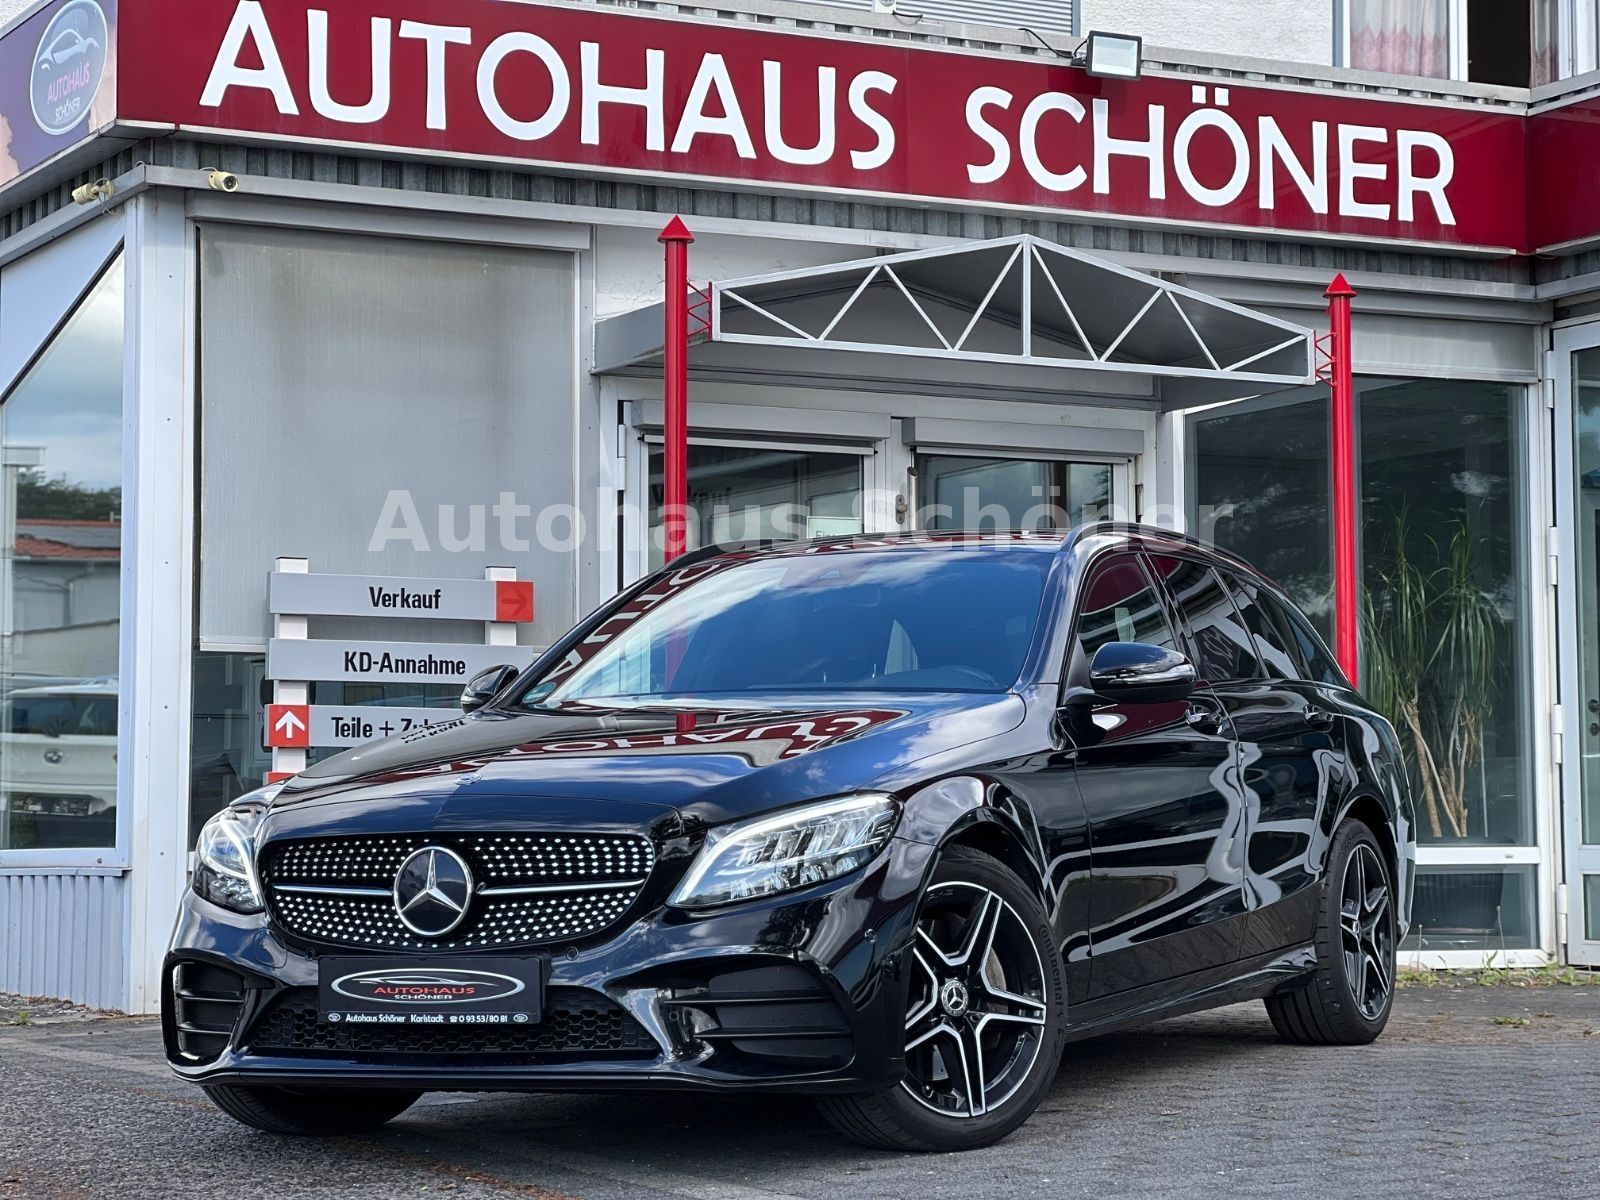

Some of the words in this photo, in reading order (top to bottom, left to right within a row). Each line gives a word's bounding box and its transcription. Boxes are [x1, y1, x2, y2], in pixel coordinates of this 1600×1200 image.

[47, 62, 90, 104] AUTOHAUS
[55, 97, 80, 121] SCHÖNER
[199, 0, 898, 170] AUTOHAUS
[965, 85, 1457, 226] SCHÖNER
[368, 586, 441, 610] Verkauf
[344, 651, 466, 675] KD-Annahme
[331, 716, 373, 738] Teile
[1039, 923, 1064, 1006] Continental
[345, 1013, 377, 1023] Autohaus
[379, 1013, 406, 1023] Schöner
[410, 1013, 443, 1023] Karlstadt
